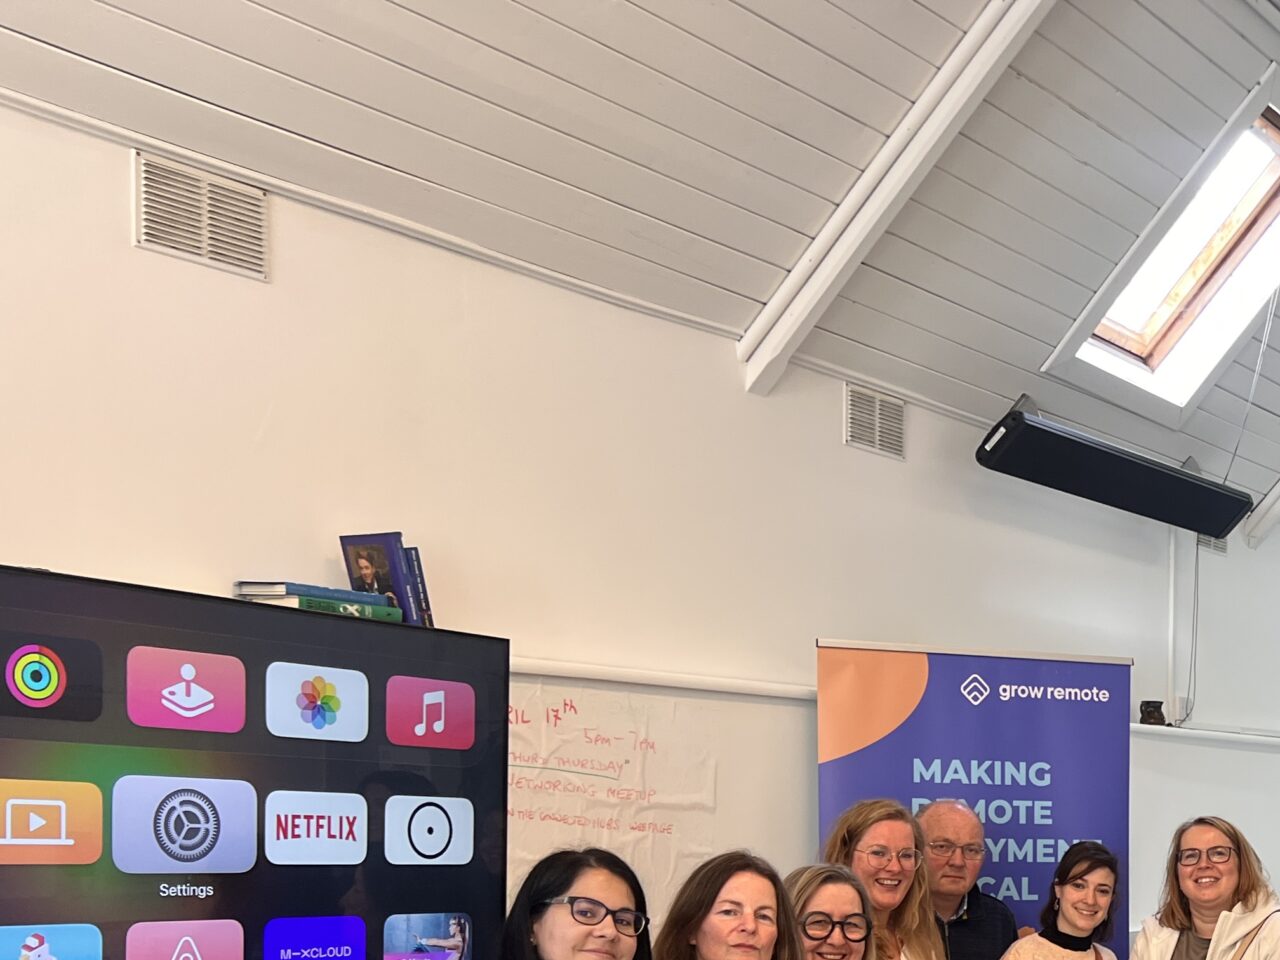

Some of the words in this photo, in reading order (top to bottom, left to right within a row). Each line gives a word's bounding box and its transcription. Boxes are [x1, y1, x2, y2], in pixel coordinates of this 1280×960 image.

[999, 683, 1043, 701] grow
[1047, 684, 1109, 702] remote
[508, 705, 530, 724] RIL
[912, 757, 1051, 787] MAKING
[276, 814, 357, 842] NETFLIX
[159, 883, 214, 898] Settings
[976, 876, 1039, 901] CAL
